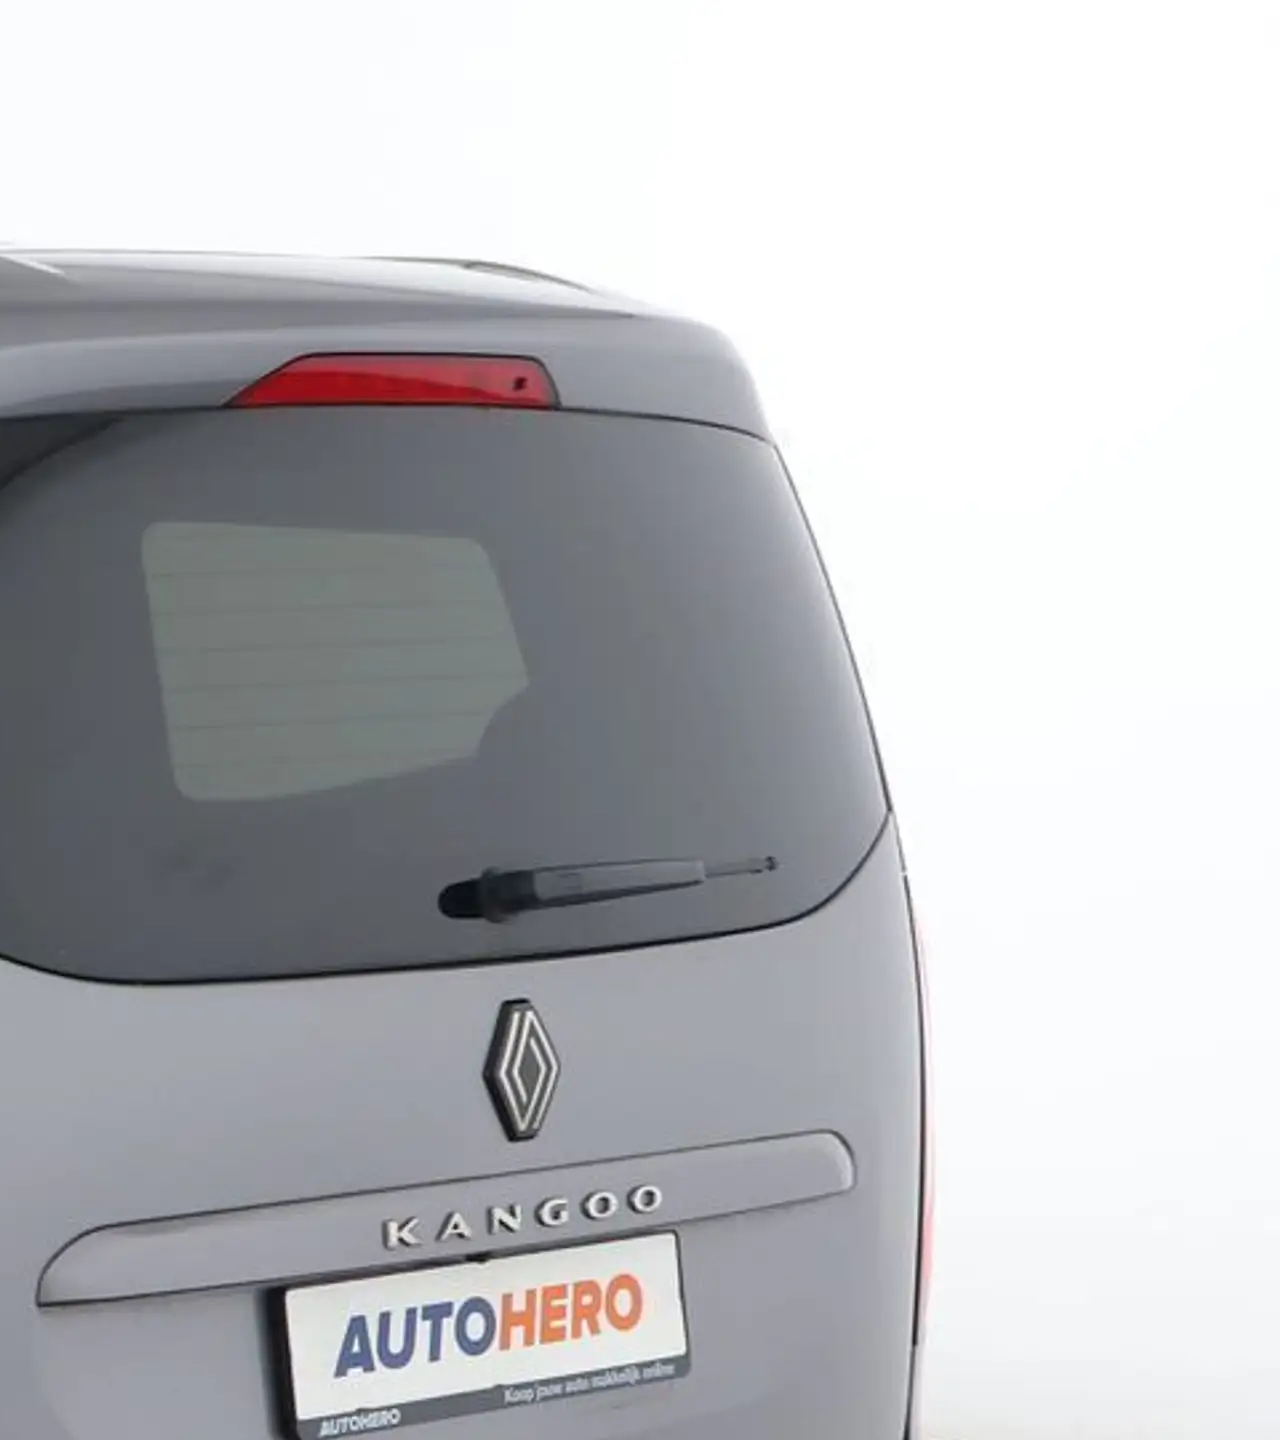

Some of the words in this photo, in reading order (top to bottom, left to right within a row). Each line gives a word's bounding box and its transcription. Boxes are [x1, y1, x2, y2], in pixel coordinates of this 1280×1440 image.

[382, 1185, 664, 1251] KANGOO
[334, 1273, 643, 1379] AUTOHERO
[318, 1408, 401, 1437] AUTOHERO
